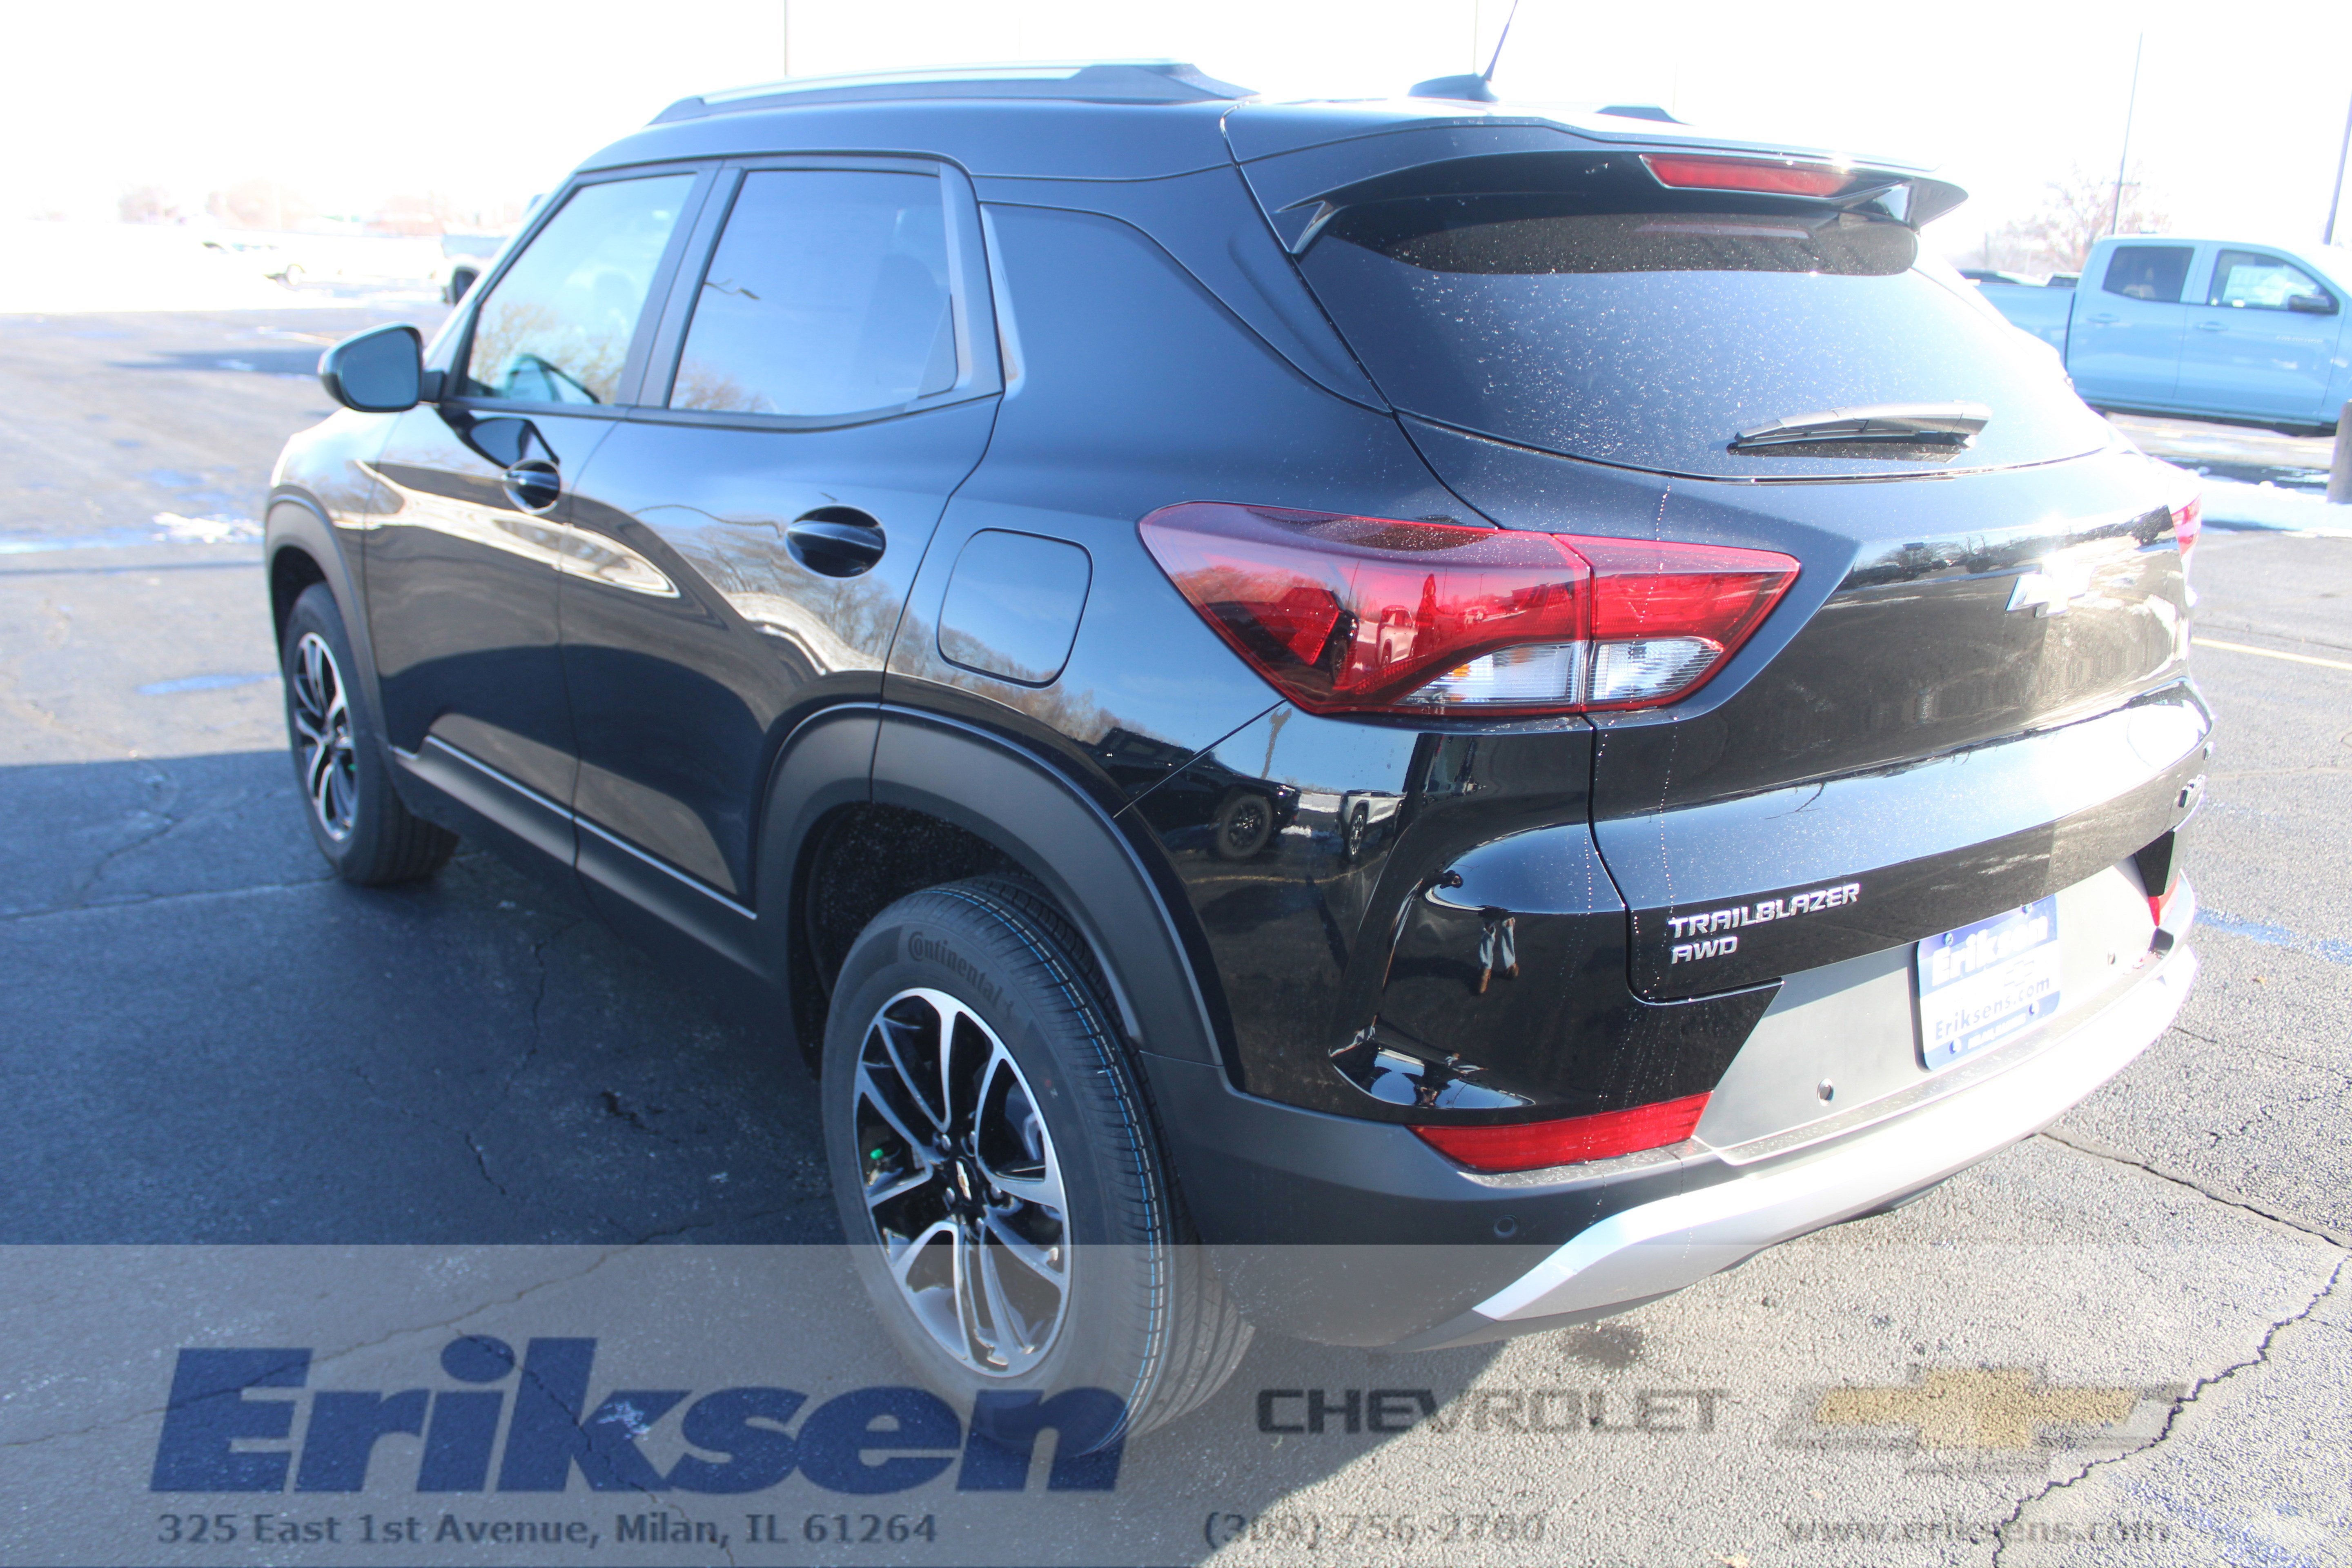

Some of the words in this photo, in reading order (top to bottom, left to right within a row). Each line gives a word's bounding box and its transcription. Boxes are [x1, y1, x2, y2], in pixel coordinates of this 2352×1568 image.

[1668, 883, 1860, 938] TRAILBLAZER
[908, 931, 1004, 1008] Continental
[1671, 936, 1738, 964] AWD
[1932, 916, 2048, 987] Eriksen
[1936, 978, 2049, 1040] Eriksens.com
